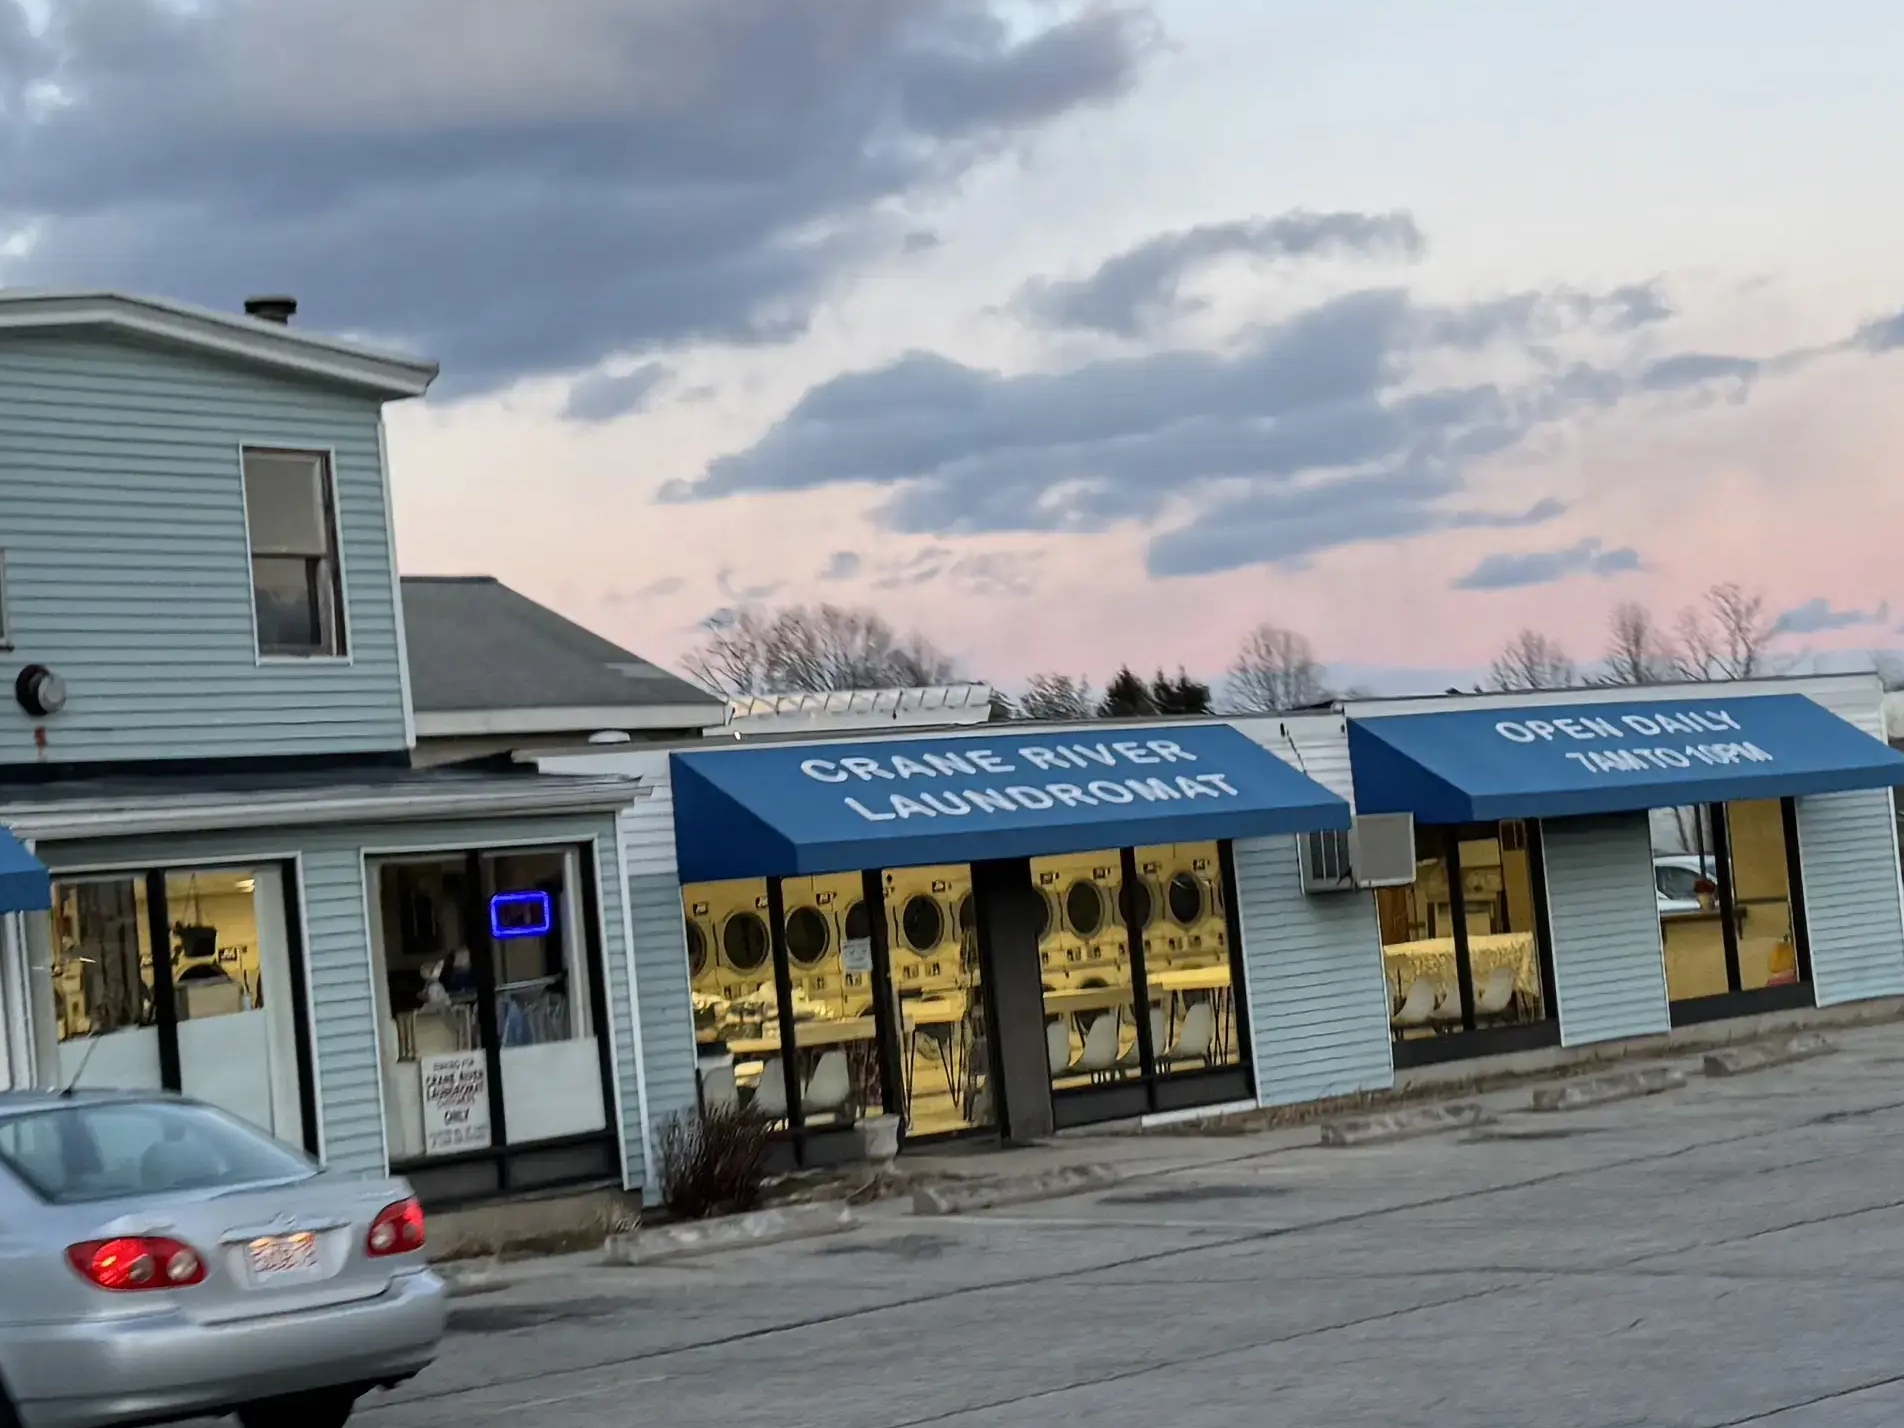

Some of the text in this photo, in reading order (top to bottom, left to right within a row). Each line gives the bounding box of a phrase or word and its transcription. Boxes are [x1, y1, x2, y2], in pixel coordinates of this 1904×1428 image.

[1495, 709, 1741, 743] OPEN DAILY
[800, 739, 1198, 783] CRANE RIVER
[844, 772, 1238, 822] LAUNDROMAT
